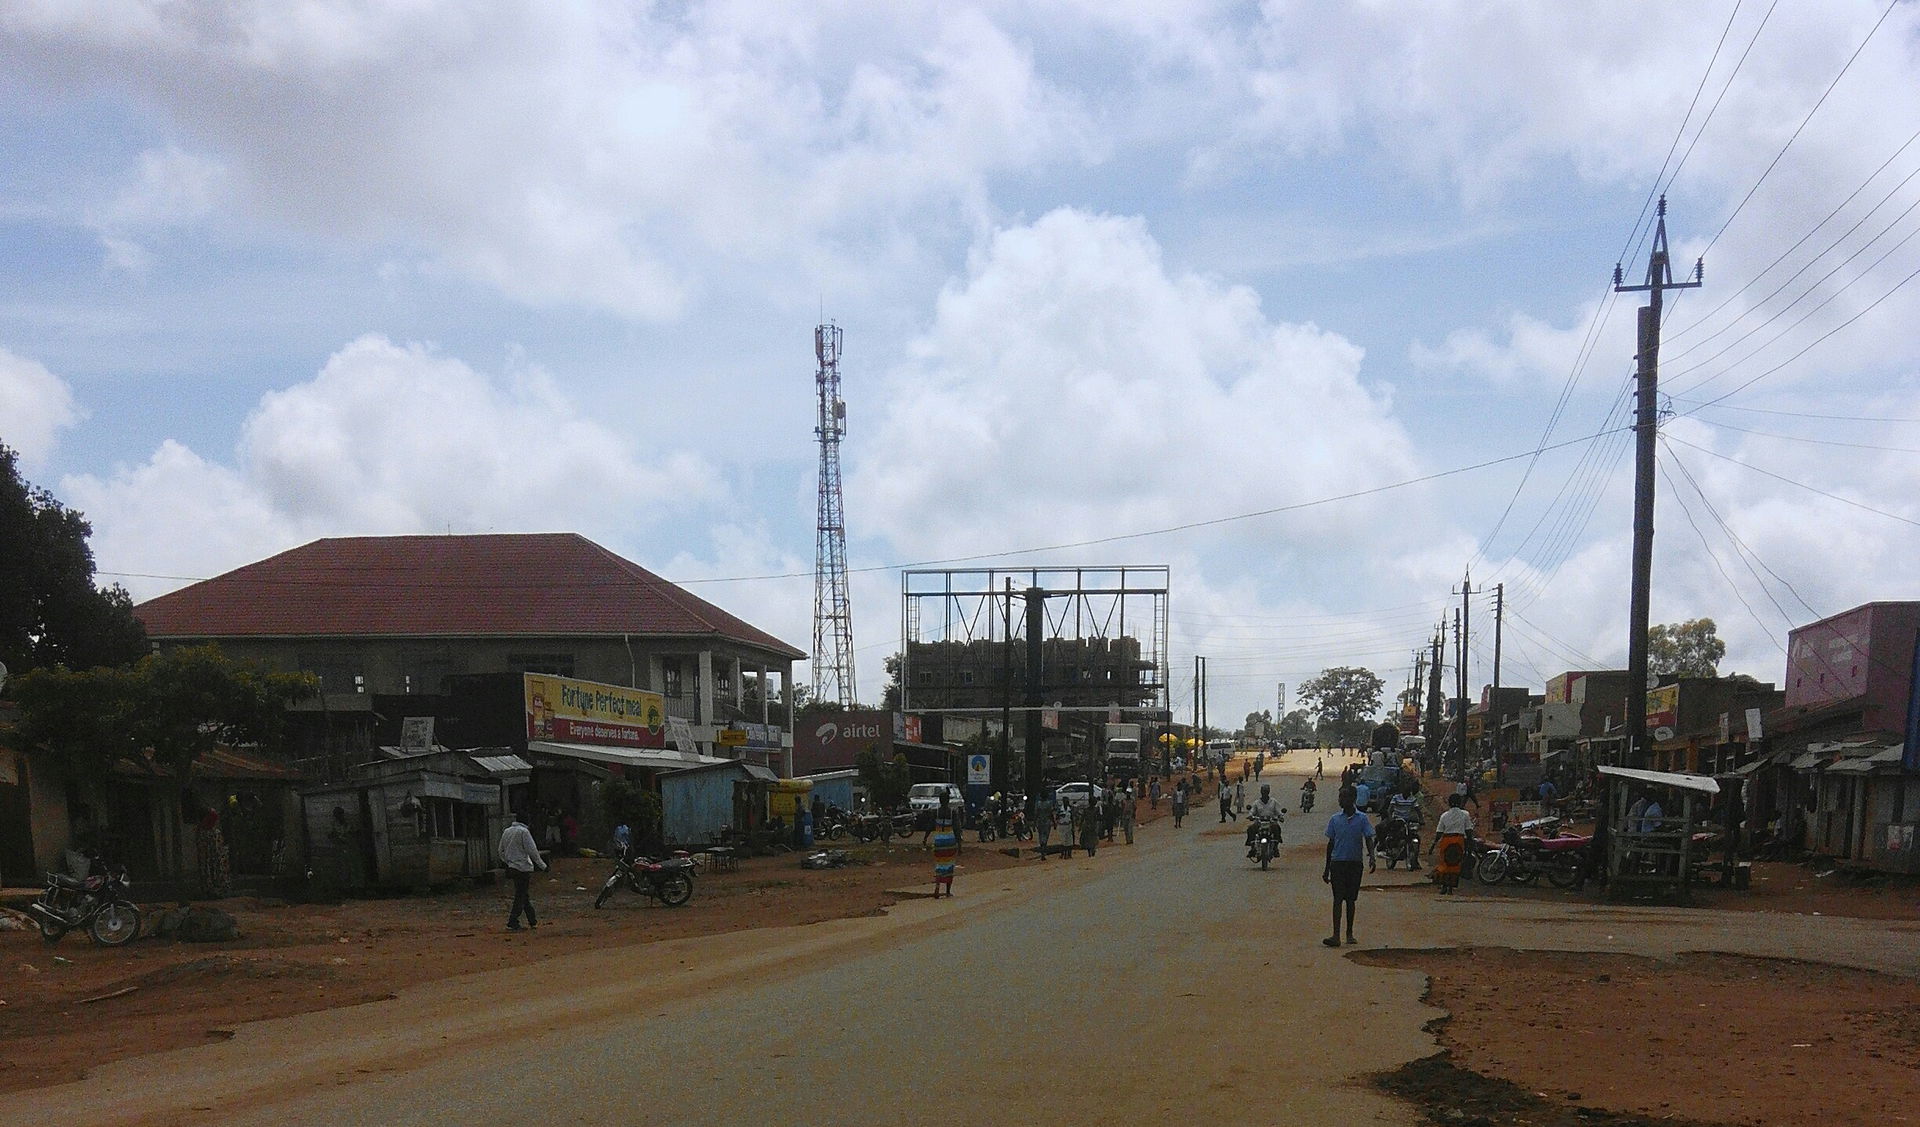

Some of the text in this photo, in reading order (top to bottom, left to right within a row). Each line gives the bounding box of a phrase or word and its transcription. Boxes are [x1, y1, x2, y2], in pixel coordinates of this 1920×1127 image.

[561, 684, 593, 710] Fortune
[595, 690, 624, 715] Perfect
[626, 696, 642, 717] meal
[569, 722, 594, 739] Everyone
[595, 725, 617, 739] deserves
[842, 724, 881, 738] airtel
